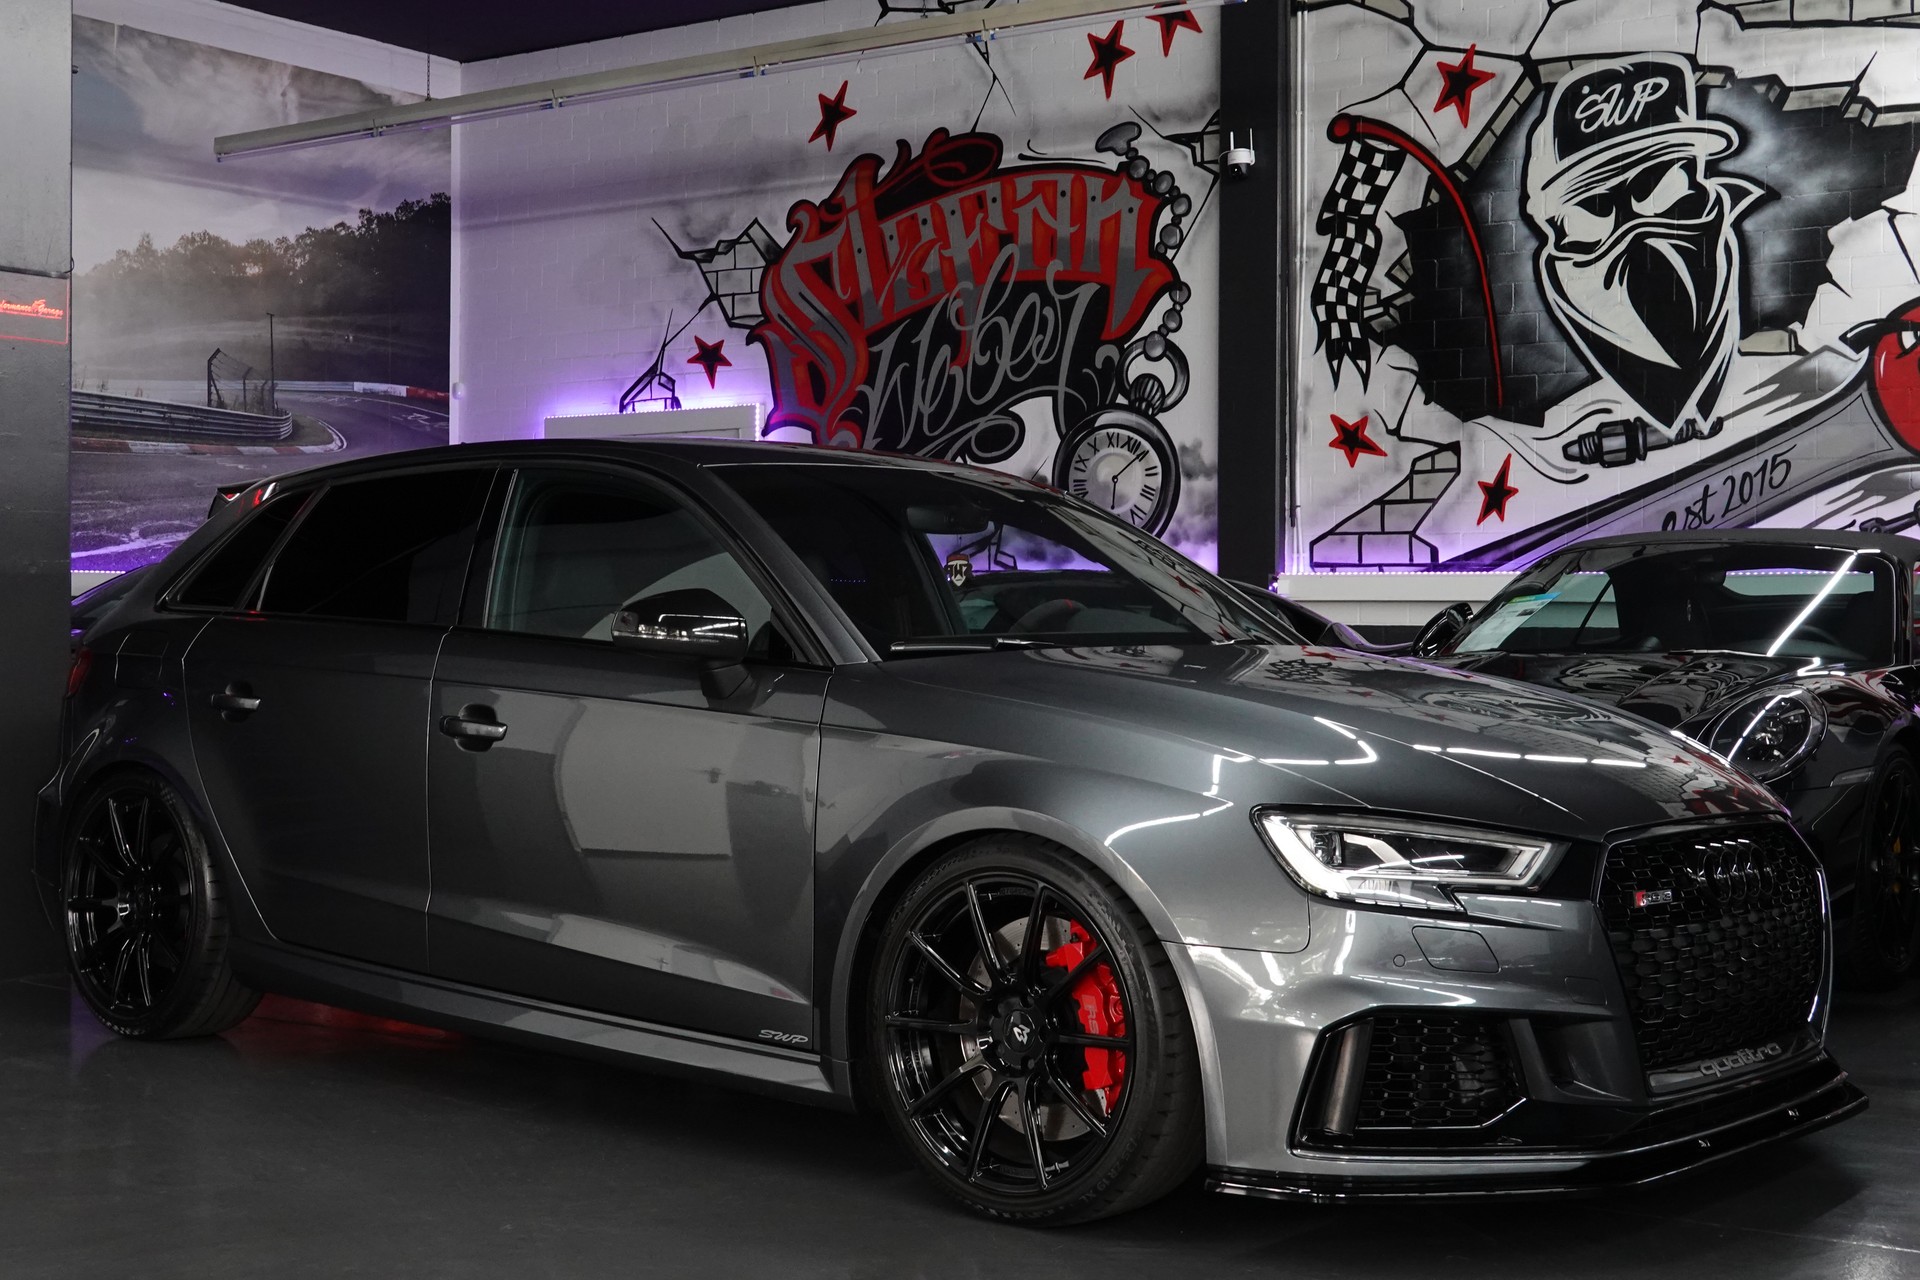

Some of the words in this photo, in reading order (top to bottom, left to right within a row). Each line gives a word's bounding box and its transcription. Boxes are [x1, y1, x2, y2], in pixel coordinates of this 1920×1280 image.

[1574, 76, 1670, 134] SWP
[1721, 443, 1798, 519] 2015
[758, 1029, 809, 1044] SWP
[1700, 1041, 1782, 1078] quattro
